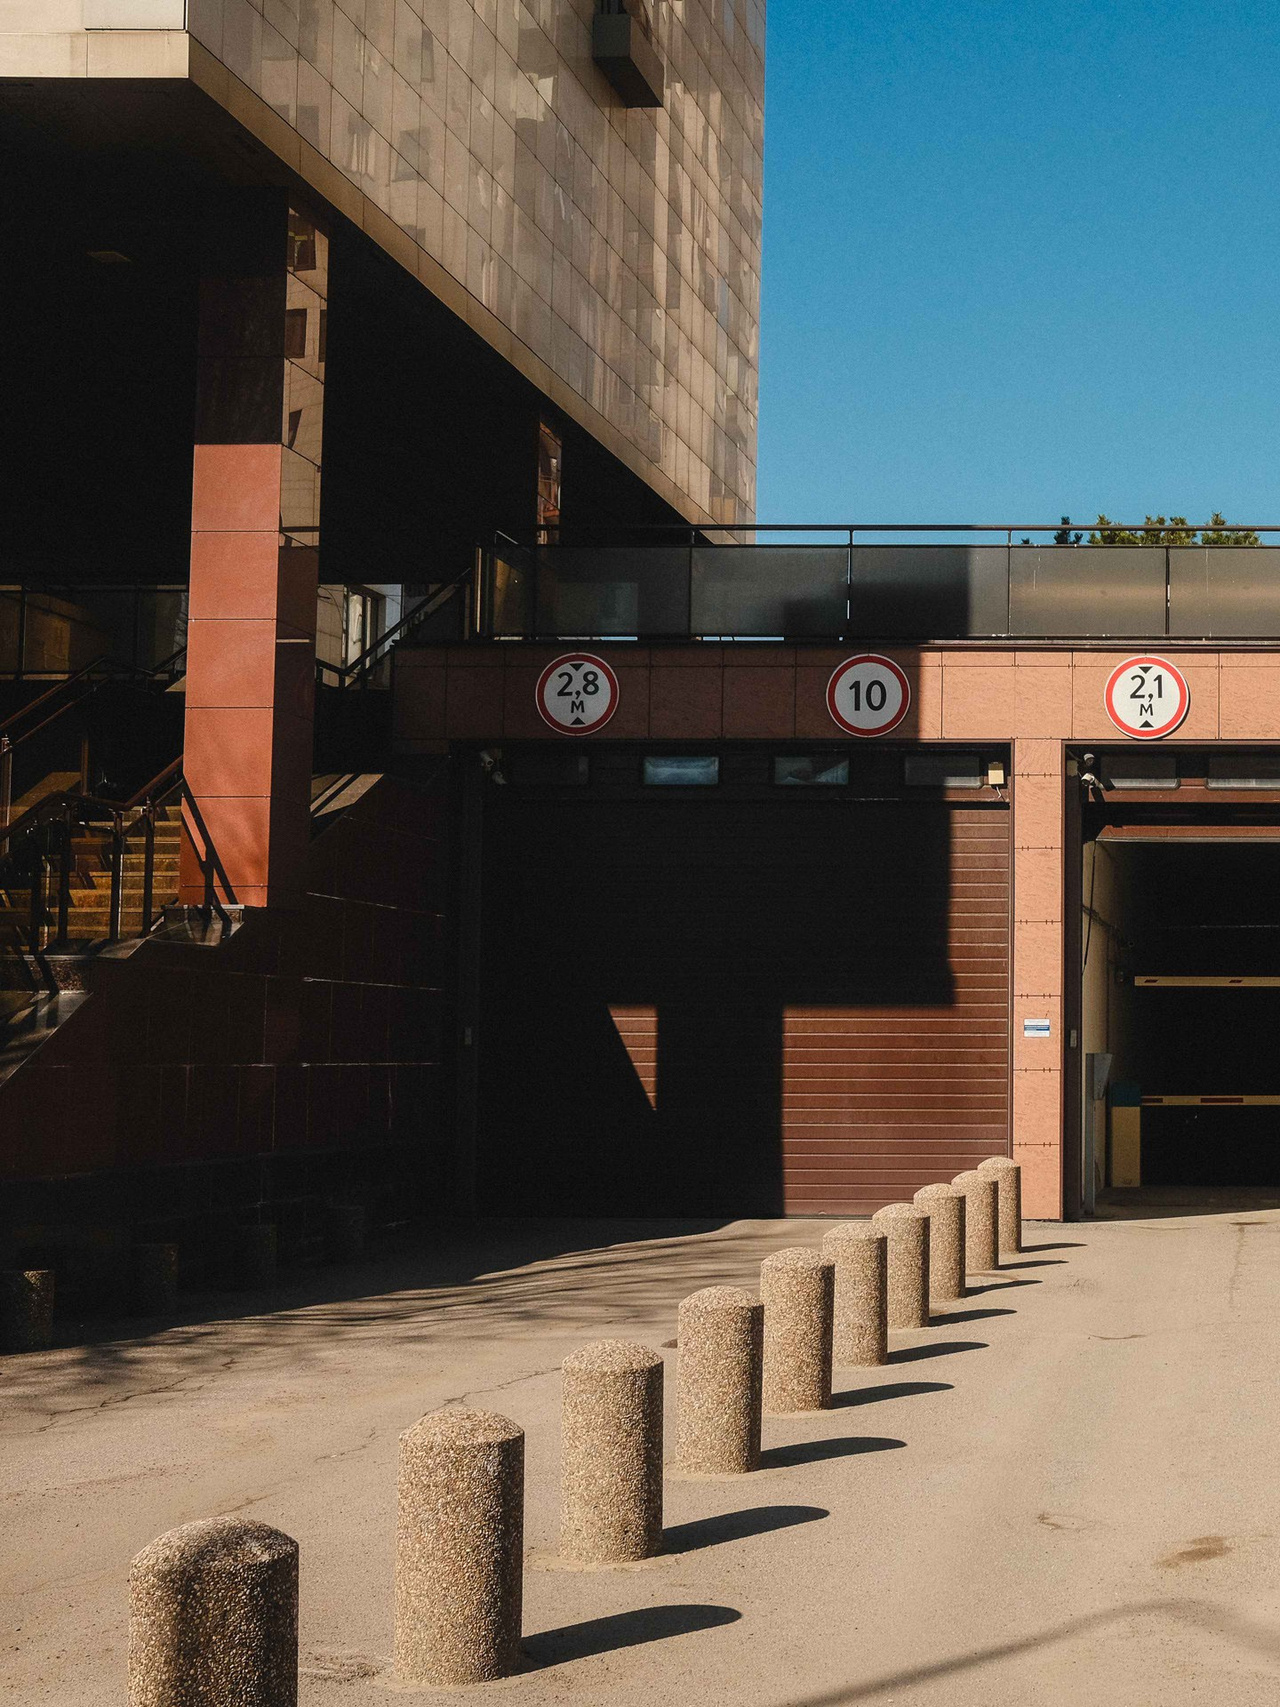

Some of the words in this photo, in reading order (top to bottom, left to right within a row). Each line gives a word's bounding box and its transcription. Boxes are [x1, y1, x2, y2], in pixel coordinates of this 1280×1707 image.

[557, 671, 600, 700] 2,8
[849, 680, 887, 712] 10
[1129, 674, 1163, 703] 2,1
